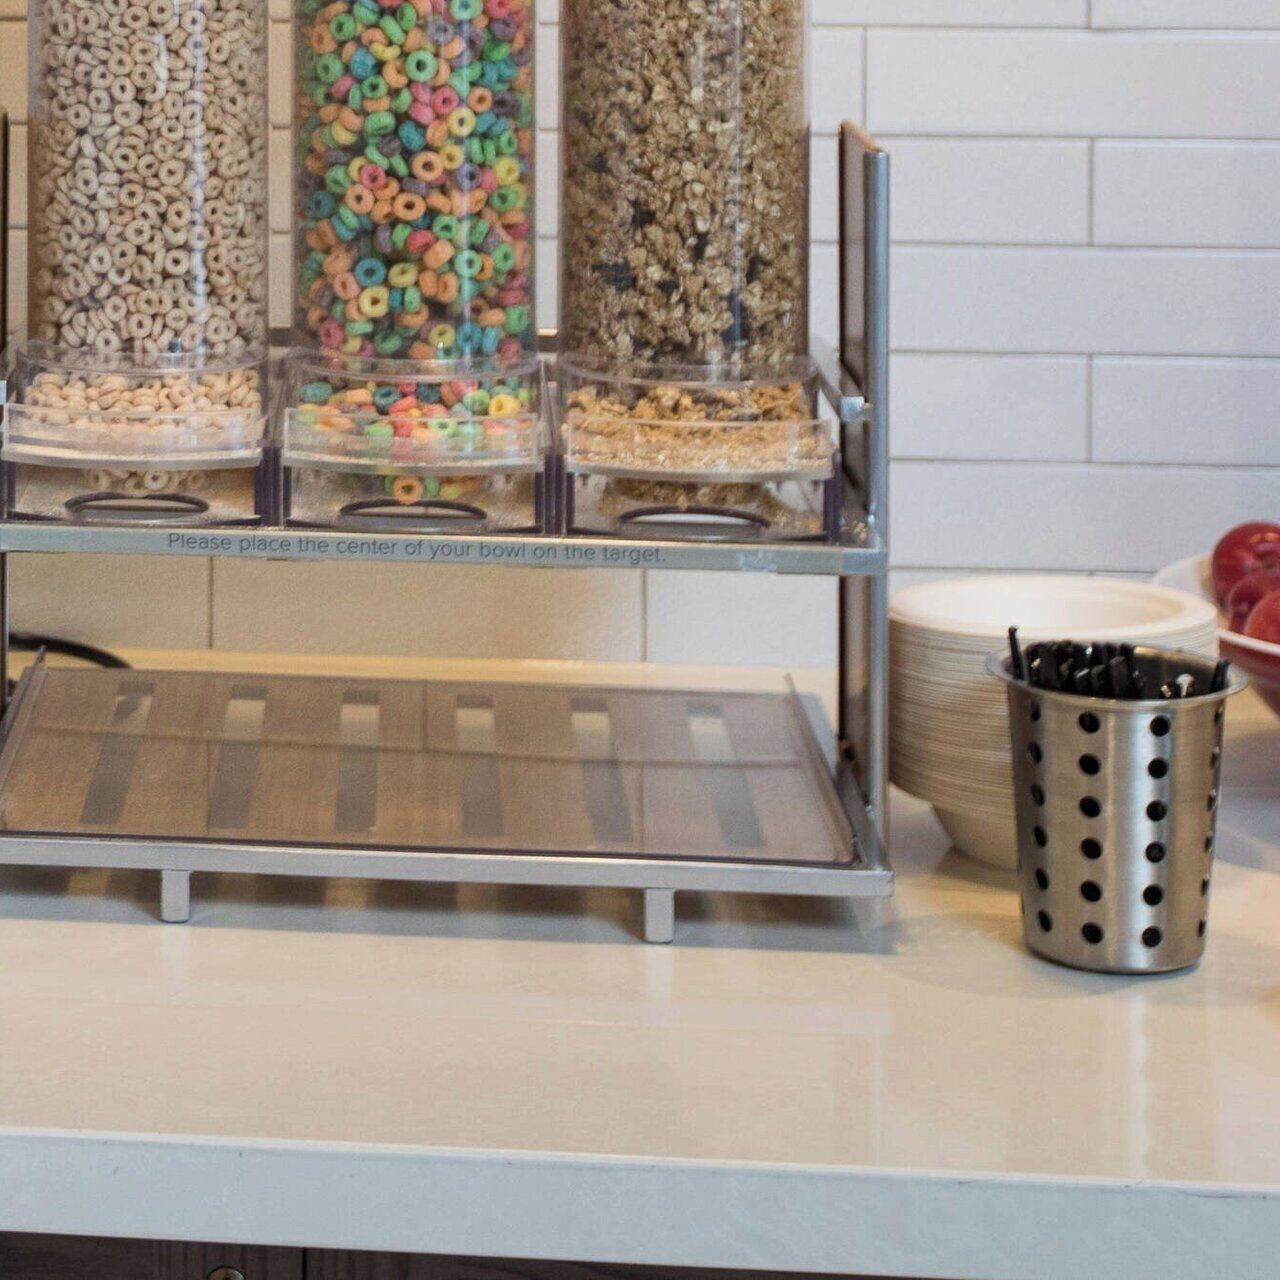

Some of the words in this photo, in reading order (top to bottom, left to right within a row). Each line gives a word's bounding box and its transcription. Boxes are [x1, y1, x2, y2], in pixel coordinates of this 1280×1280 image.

[168, 533, 232, 551] Please
[240, 535, 291, 556] place
[299, 537, 329, 554] the
[336, 538, 396, 555] center
[404, 538, 425, 556] of
[429, 542, 471, 561] your
[480, 540, 526, 559] bowl
[533, 545, 558, 560] on
[565, 544, 596, 561] the
[602, 545, 665, 565] target.
